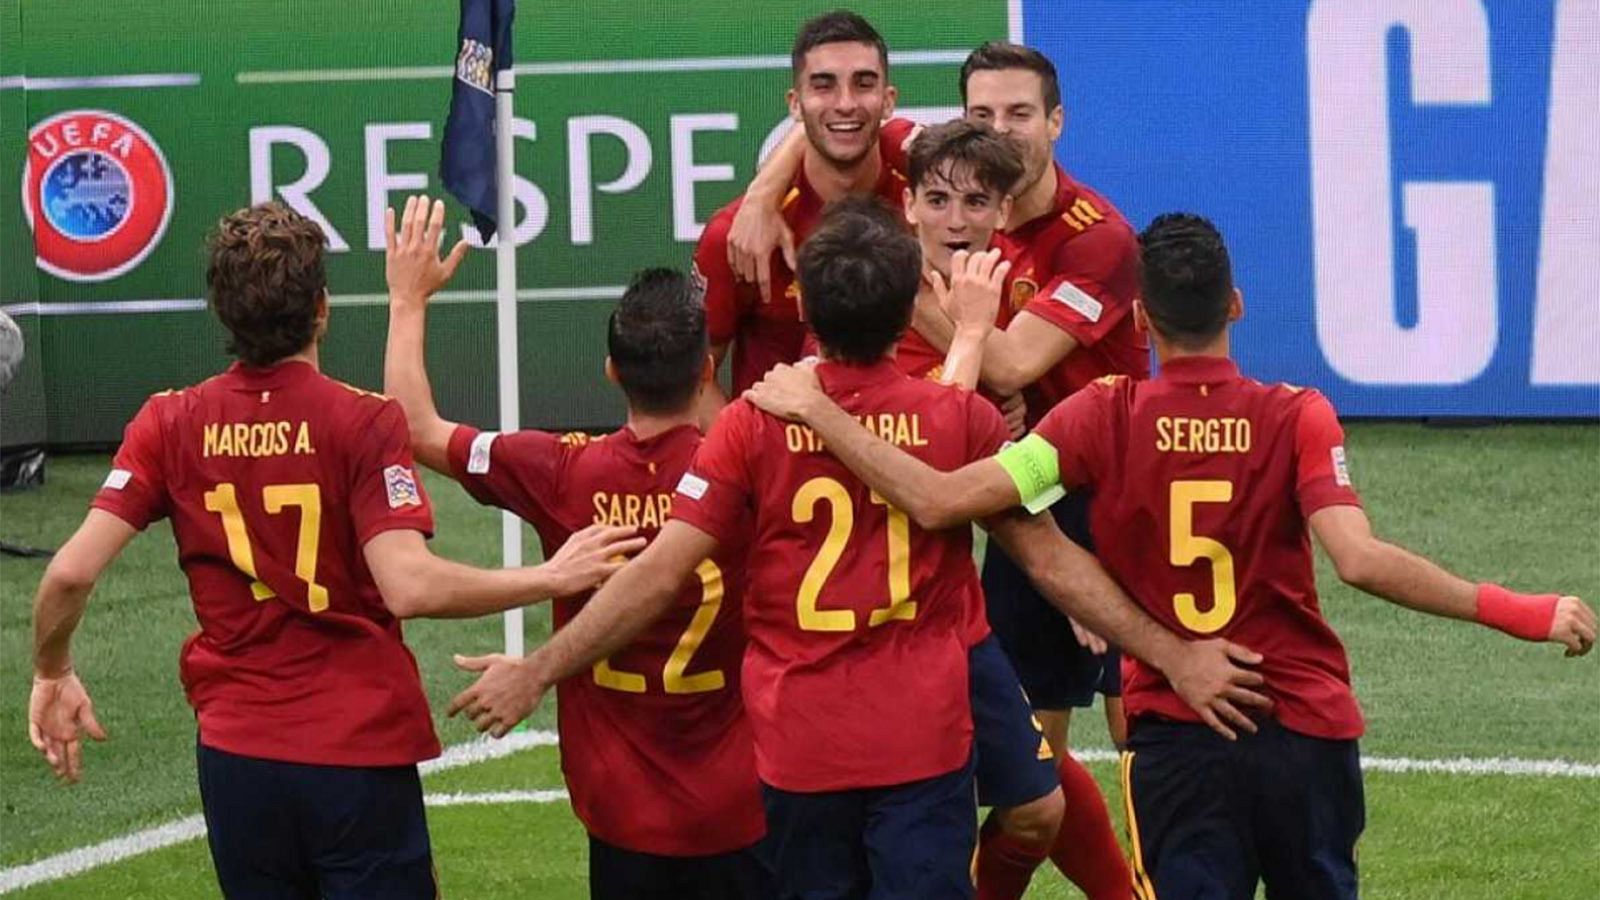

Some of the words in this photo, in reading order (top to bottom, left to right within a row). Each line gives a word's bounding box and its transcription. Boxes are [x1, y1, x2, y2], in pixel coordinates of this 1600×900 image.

[33, 120, 134, 158] UEFA
[249, 106, 966, 251] RESPE
[203, 421, 291, 458] MARCOS
[294, 421, 316, 454] A.
[1156, 416, 1250, 453] SERGIO
[204, 482, 329, 613] 17
[792, 476, 918, 632] 21
[1170, 480, 1236, 633] 5
